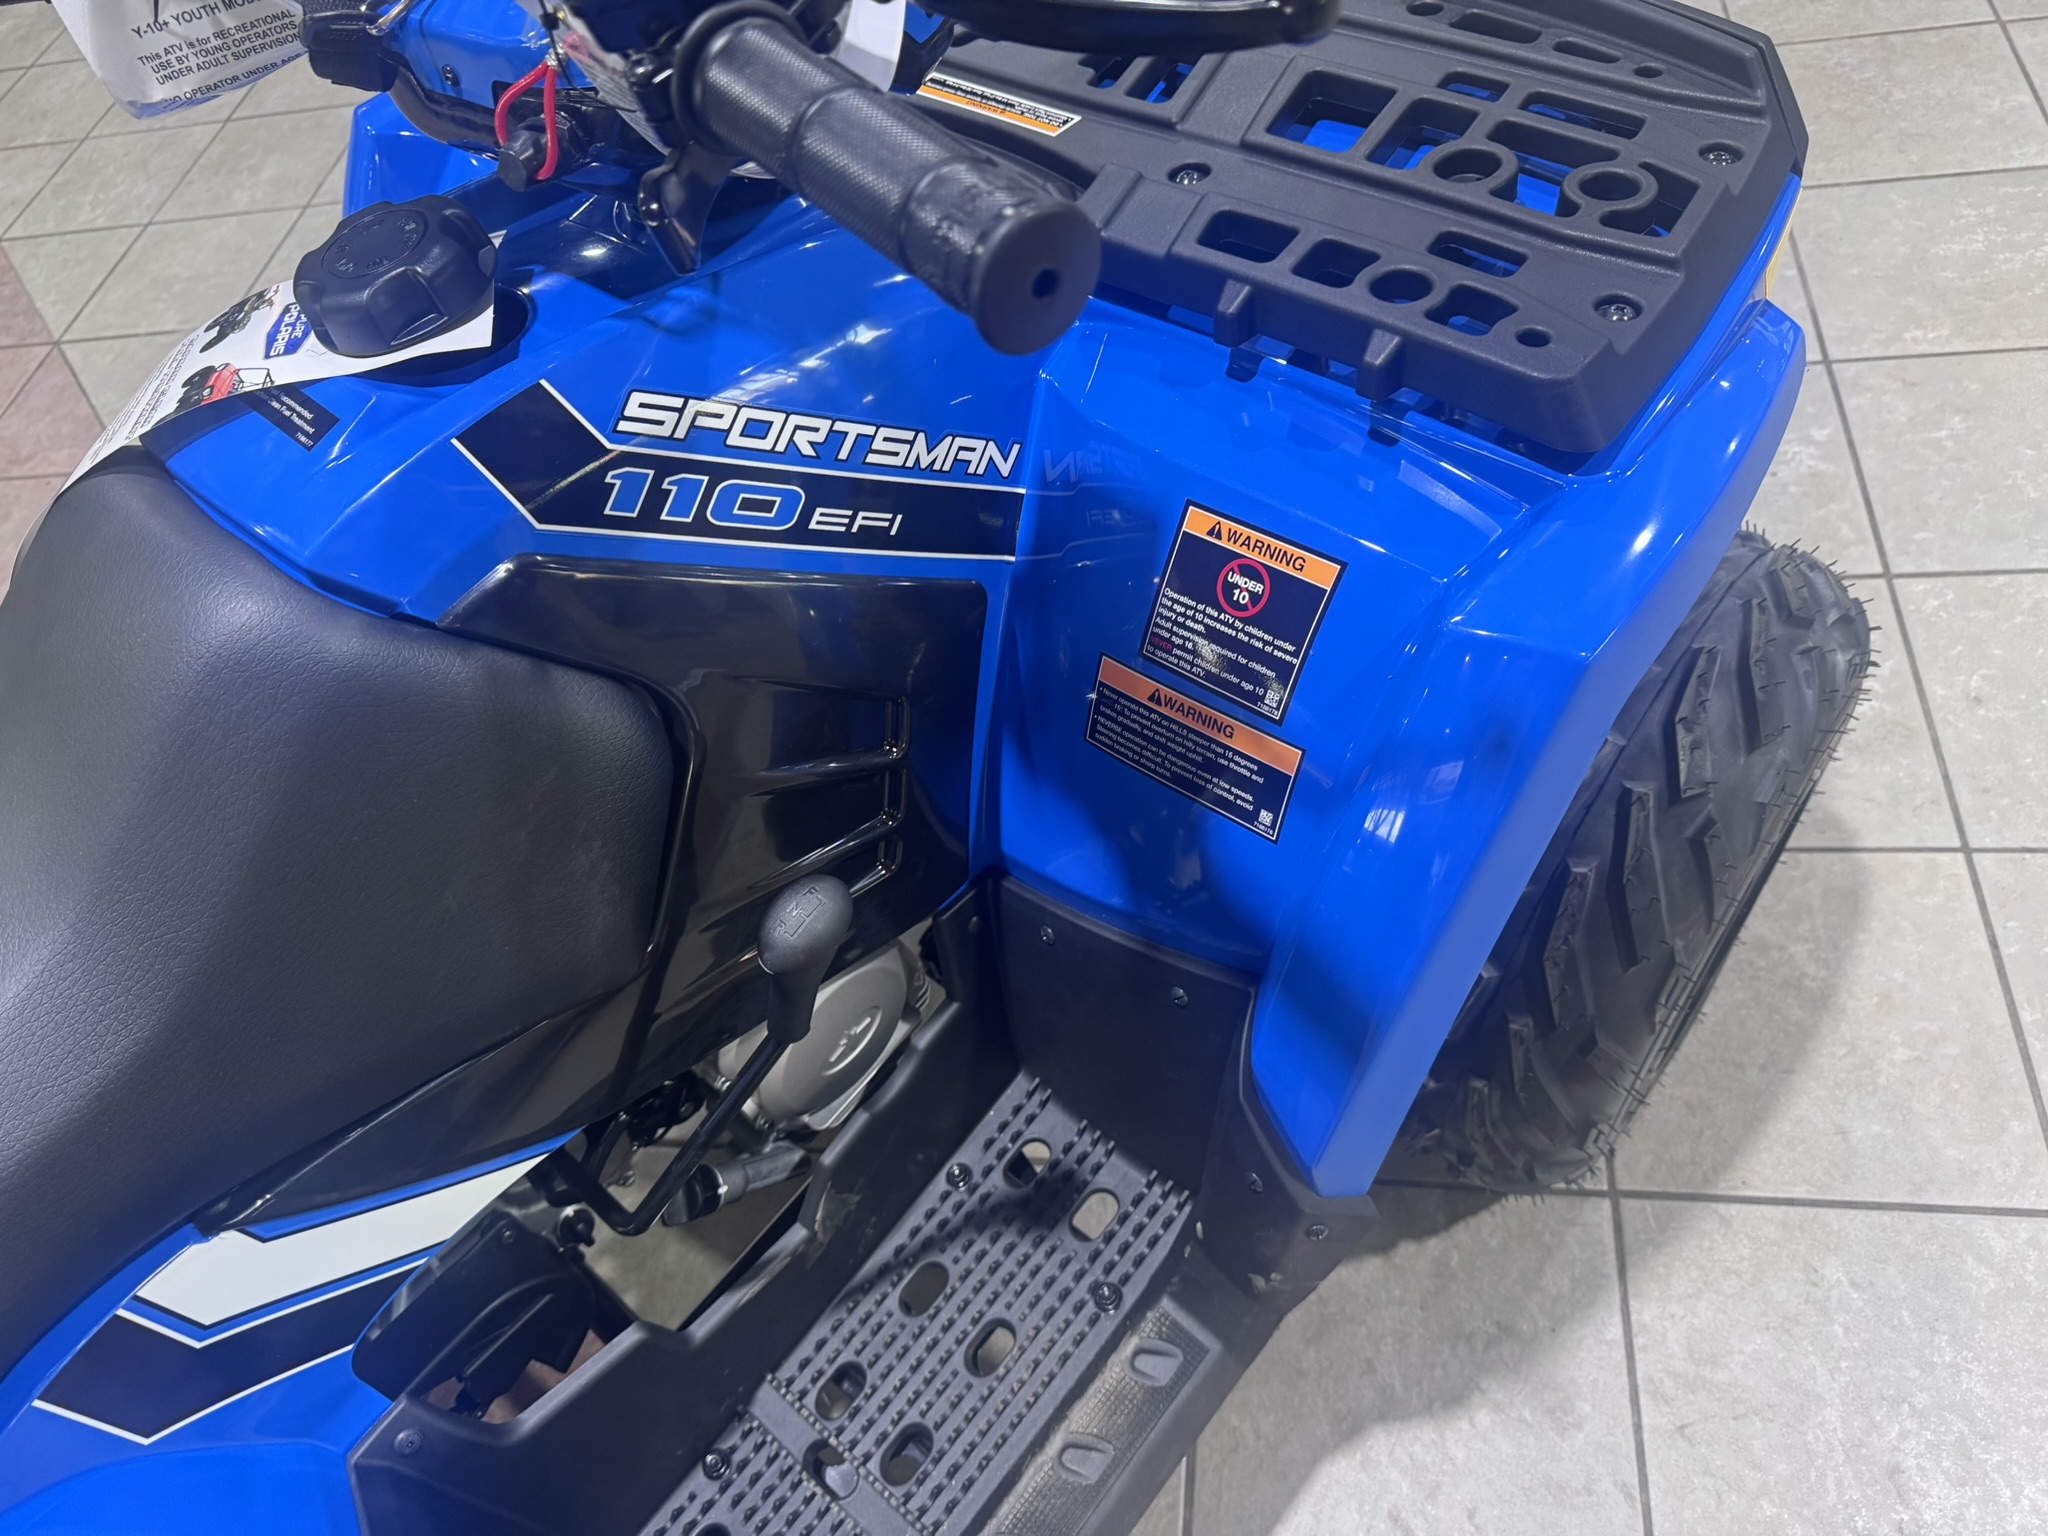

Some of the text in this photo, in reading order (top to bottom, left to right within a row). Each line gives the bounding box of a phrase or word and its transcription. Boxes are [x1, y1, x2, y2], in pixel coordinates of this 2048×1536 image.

[131, 19, 170, 39] Y-10+
[171, 2, 221, 26] YOUTH
[137, 9, 296, 66] This ATV is for RECREATIONAL
[150, 20, 298, 74] USE BY YOUNG OPERATORS
[155, 31, 300, 86] UNDER ADULT SUPERVISION
[183, 75, 241, 100] OPERATOR
[242, 62, 278, 79] UNDER
[269, 304, 300, 356] POLARIS
[279, 392, 314, 420] Recommended
[280, 405, 293, 417] Fuel
[290, 413, 315, 434] Treatment
[614, 390, 1023, 478] SPORTSMAN
[603, 467, 903, 536] 110 EFI
[1224, 527, 1307, 573] WARNING
[1226, 571, 1264, 595] UNDER
[1230, 587, 1250, 605] 10
[1152, 624, 1171, 639] under
[1170, 635, 1183, 646] age
[1157, 605, 1207, 633] injury or death.
[1161, 595, 1298, 665] the age of 10 increases the risk of severe
[1163, 586, 1296, 652] Operation of this ATV by children under
[1147, 644, 1154, 652] to
[1153, 648, 1178, 665] operate
[1178, 659, 1191, 670] this
[1155, 615, 1276, 678] Adult supervision required for children
[1171, 646, 1193, 663] permit
[1193, 655, 1220, 674] children
[1219, 669, 1240, 684] under
[1239, 680, 1254, 693] age
[1254, 686, 1264, 696] 10
[1162, 693, 1235, 740] WARNING
[1149, 711, 1161, 722] ATV
[1169, 721, 1187, 736] HILLS
[1187, 731, 1209, 747] steeper
[1210, 742, 1224, 754] than
[1224, 749, 1233, 758] 15
[1232, 754, 1258, 772] degrees
[1196, 768, 1211, 780] even
[1212, 775, 1218, 783] at
[1218, 778, 1230, 789] low
[1230, 784, 1255, 802] speeds.
[1217, 757, 1228, 766] use
[1229, 761, 1251, 777] throttle
[1250, 772, 1264, 784] and
[1205, 781, 1212, 789] of
[1212, 785, 1235, 803] control,
[1235, 797, 1253, 811] avoid
[803, 884, 820, 896] F
[786, 901, 803, 918] N
